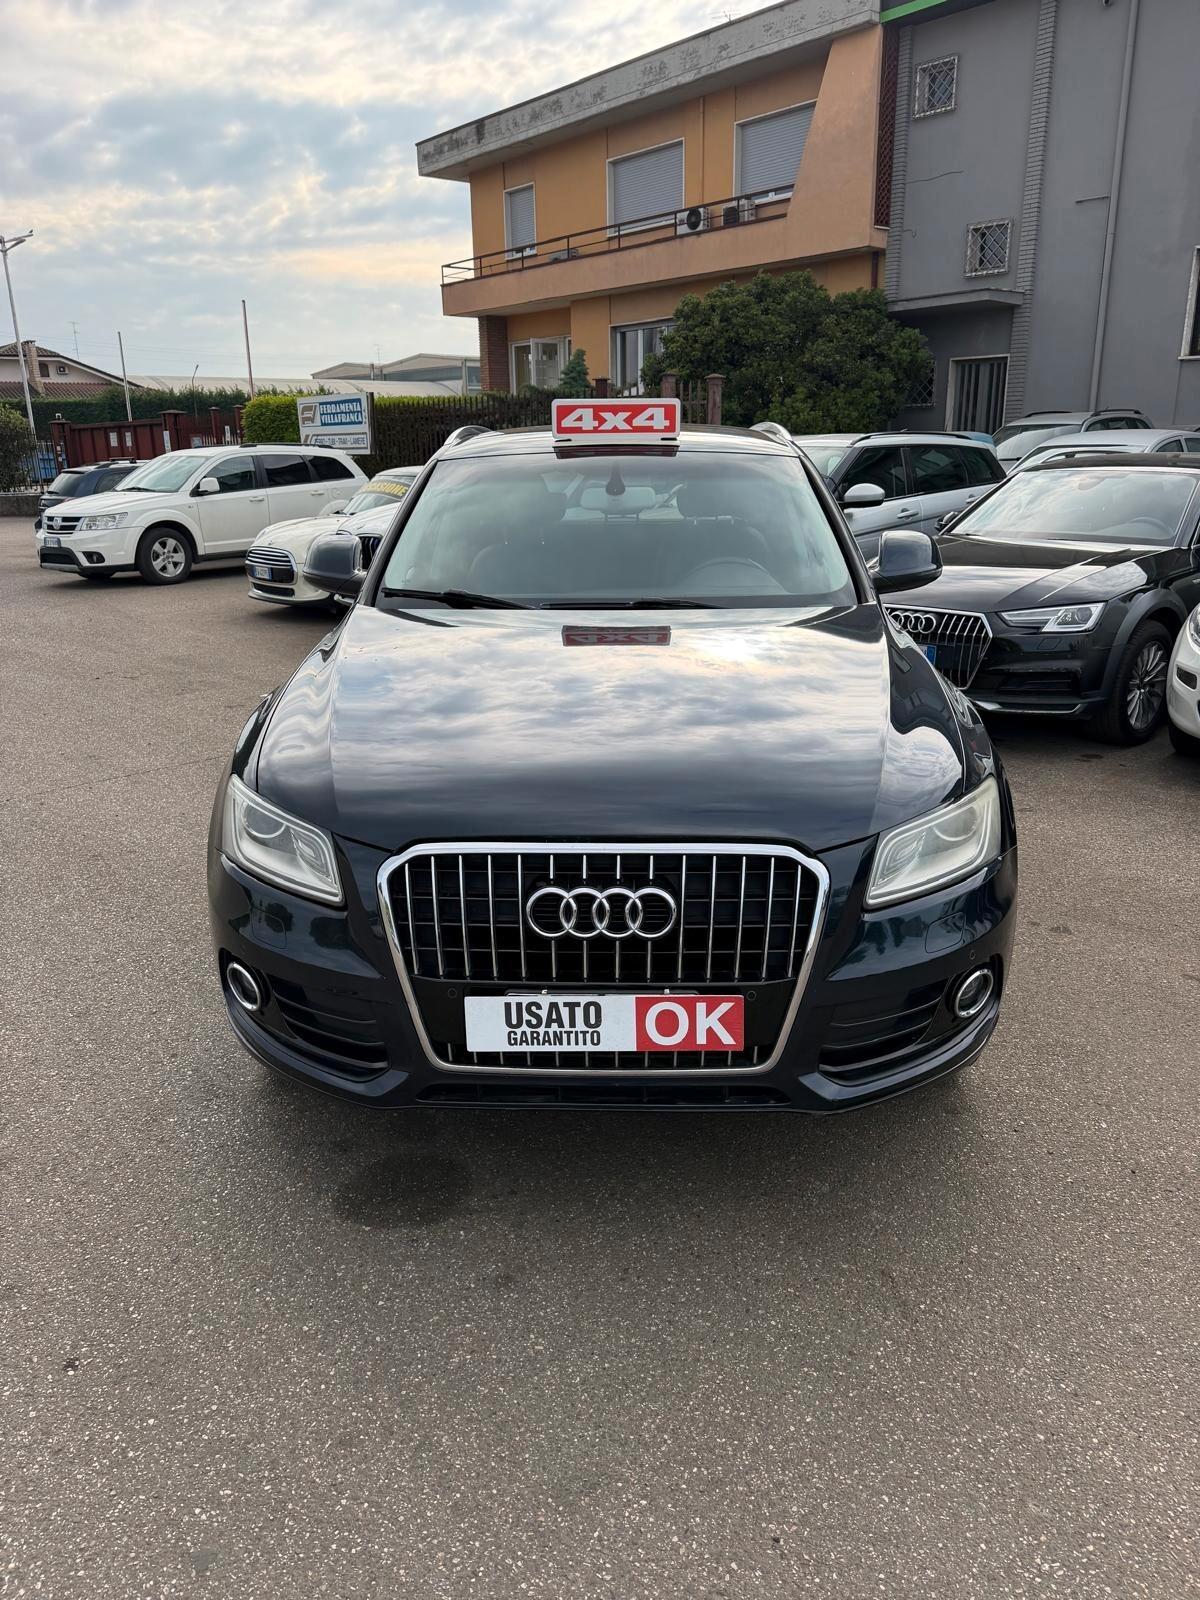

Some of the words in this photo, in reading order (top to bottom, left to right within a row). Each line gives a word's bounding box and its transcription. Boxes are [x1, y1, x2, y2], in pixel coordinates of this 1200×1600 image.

[320, 402, 361, 414] FERRAMENTA
[321, 412, 363, 424] VILLAFRANCA
[561, 407, 670, 430] 4x4
[504, 1001, 602, 1029] USATO
[645, 1001, 736, 1046] OK
[507, 1030, 601, 1046] GARANTITO
